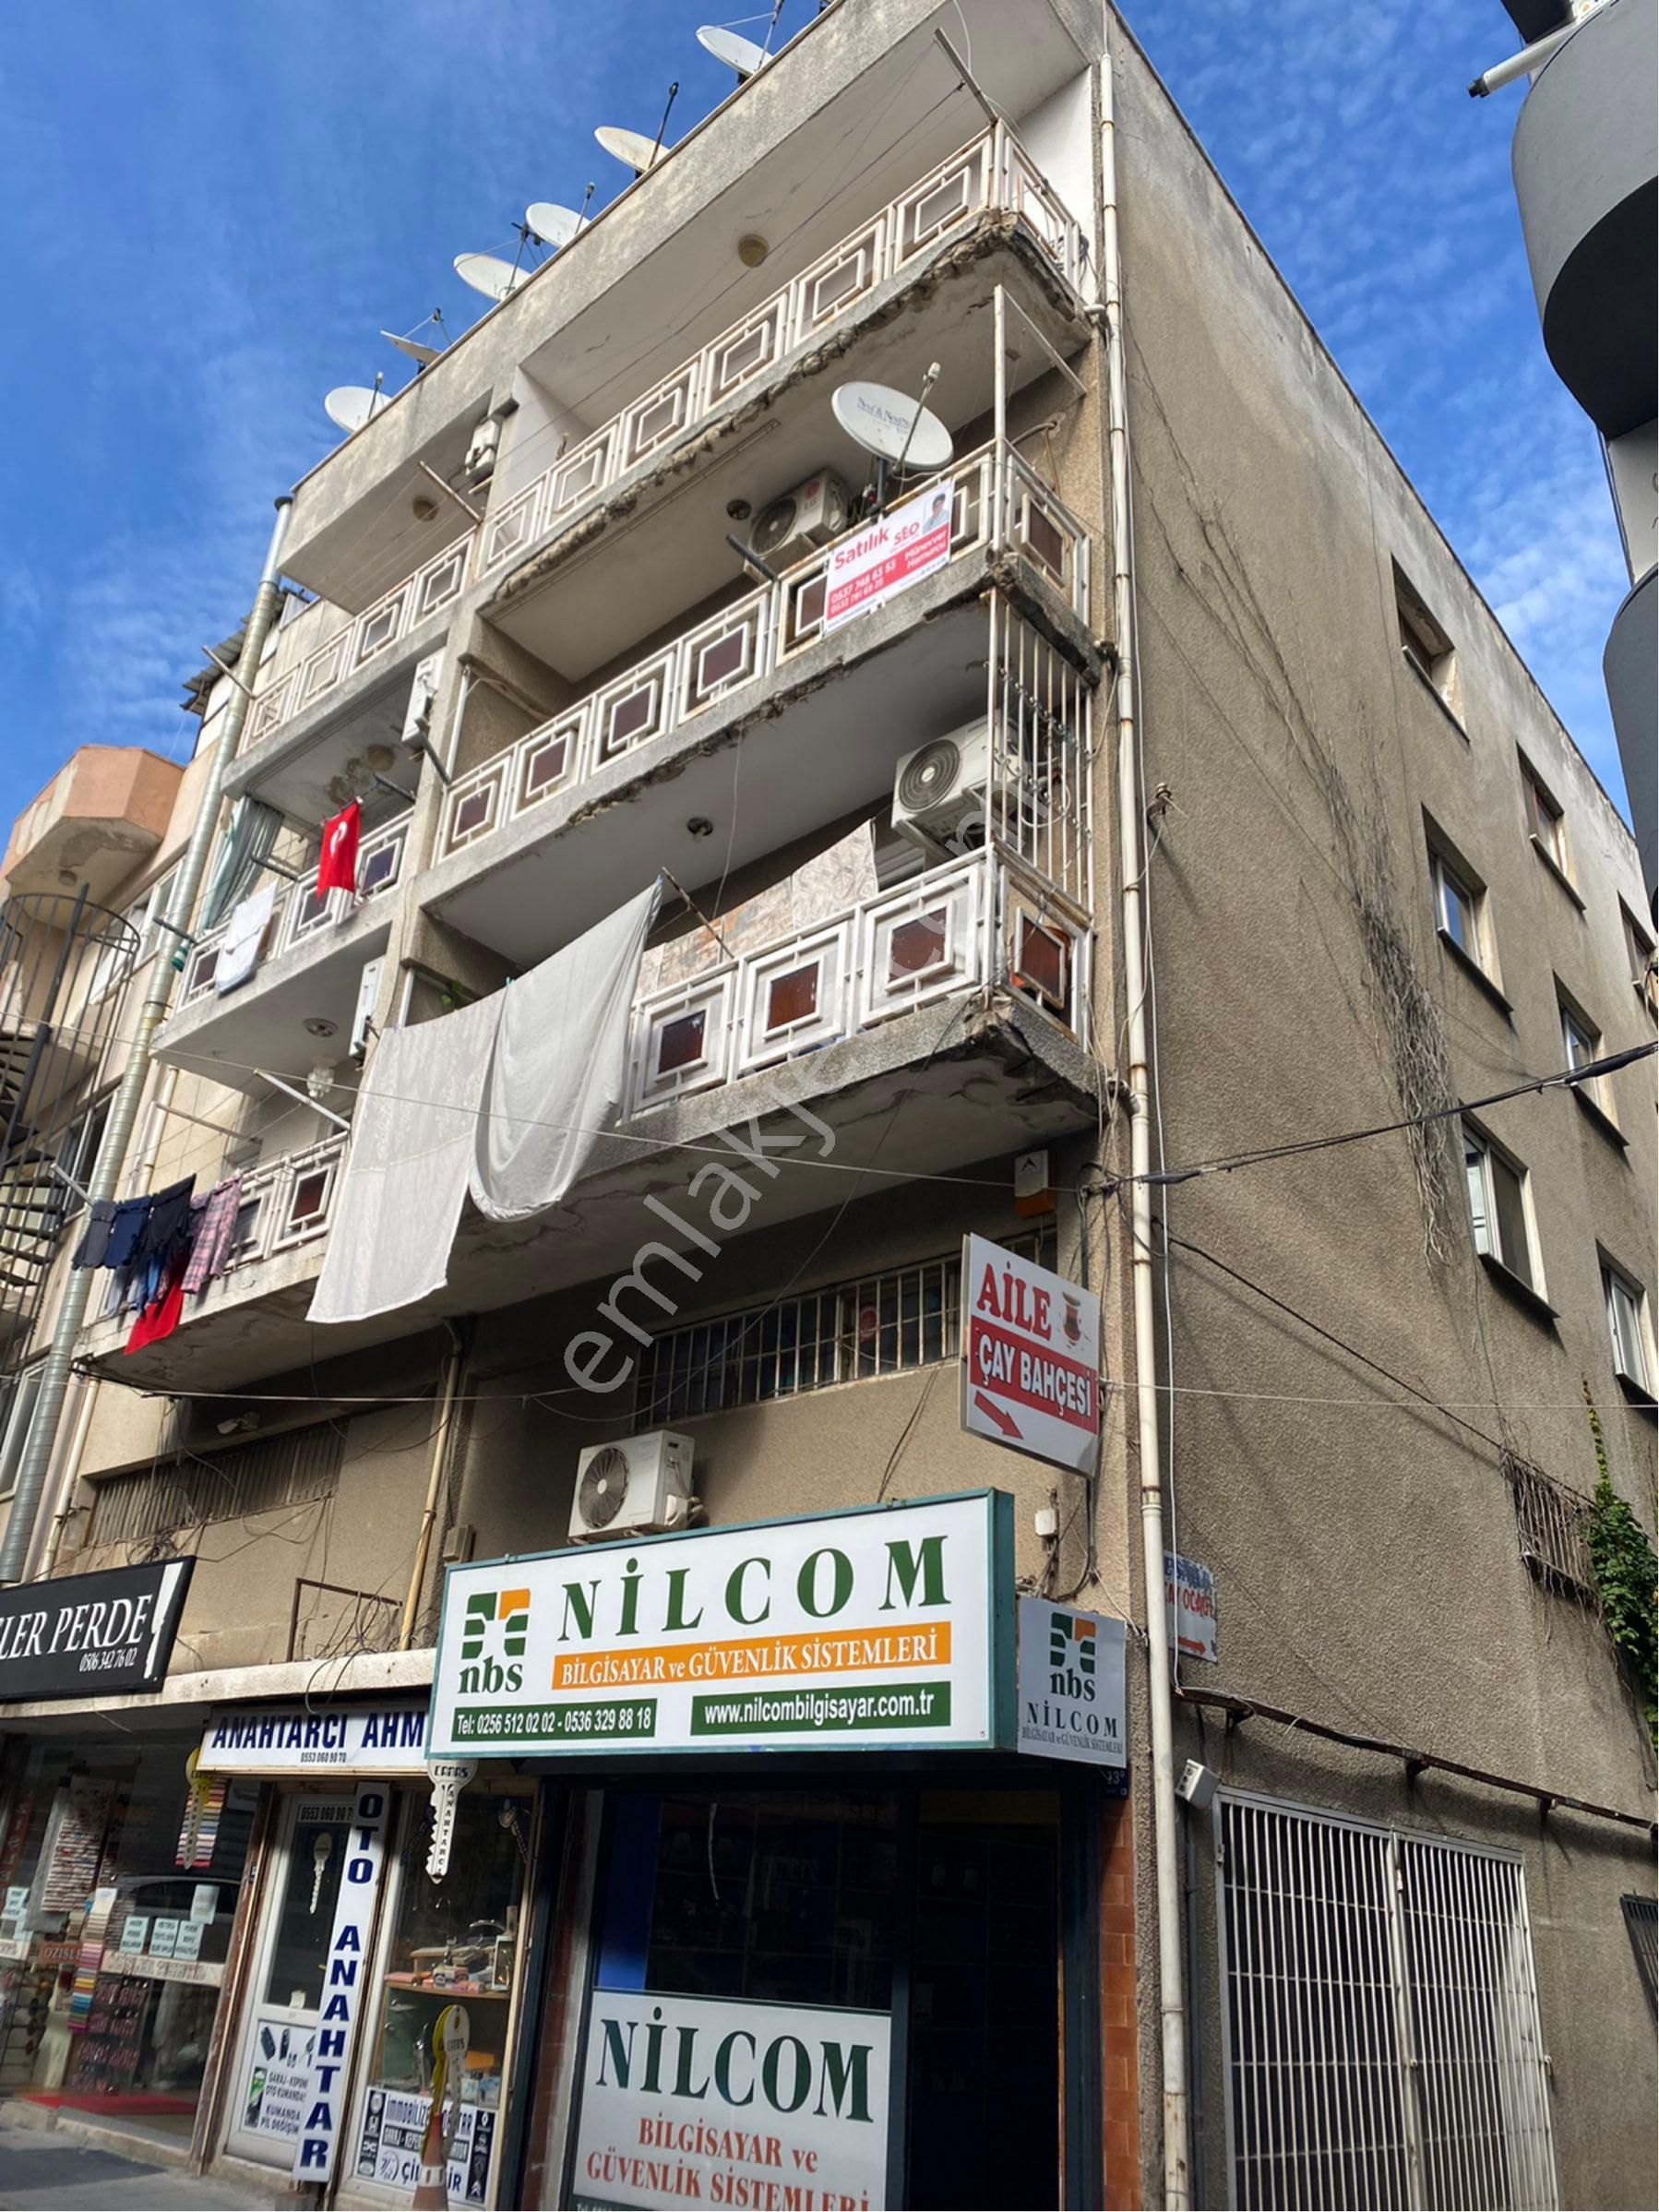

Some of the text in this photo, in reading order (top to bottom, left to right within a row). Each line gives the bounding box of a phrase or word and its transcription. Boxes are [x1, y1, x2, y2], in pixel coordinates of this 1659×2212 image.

[834, 526, 889, 569] Satılık
[976, 1261, 1052, 1341] AİLE
[979, 1333, 1092, 1417] ÇAY BAHÇESİ
[557, 1536, 951, 1641] NİLCOM
[0, 1594, 153, 1660] LER PERDE
[458, 1656, 523, 1694] nbs
[561, 1628, 937, 1686] BİLGİSAYAR ve GÜVENLİK SİSTEMLERİ
[704, 1689, 934, 1726] www.nilcombilgisayar.com.tr
[1050, 1668, 1095, 1702] nbs
[211, 1713, 348, 1749] ANAHTARCI
[458, 1714, 474, 1735] Tel:
[477, 1715, 502, 1734] 0256
[505, 1714, 522, 1733] 512
[526, 1713, 539, 1733] 02
[542, 1712, 555, 1732] 02
[565, 1711, 591, 1732] 0536
[594, 1709, 616, 1730] 329
[618, 1708, 633, 1729] 88
[637, 1706, 651, 1729] 18
[1027, 1700, 1117, 1738] NİLCOM
[346, 1806, 353, 1821] 7
[347, 1793, 384, 1884] OTO
[300, 1925, 361, 2168] ANAHTAR
[595, 2005, 874, 2123] NİLCOM
[639, 2112, 818, 2173] BİLGİSAYAR ve
[587, 2146, 701, 2198] GÜVENLİK
